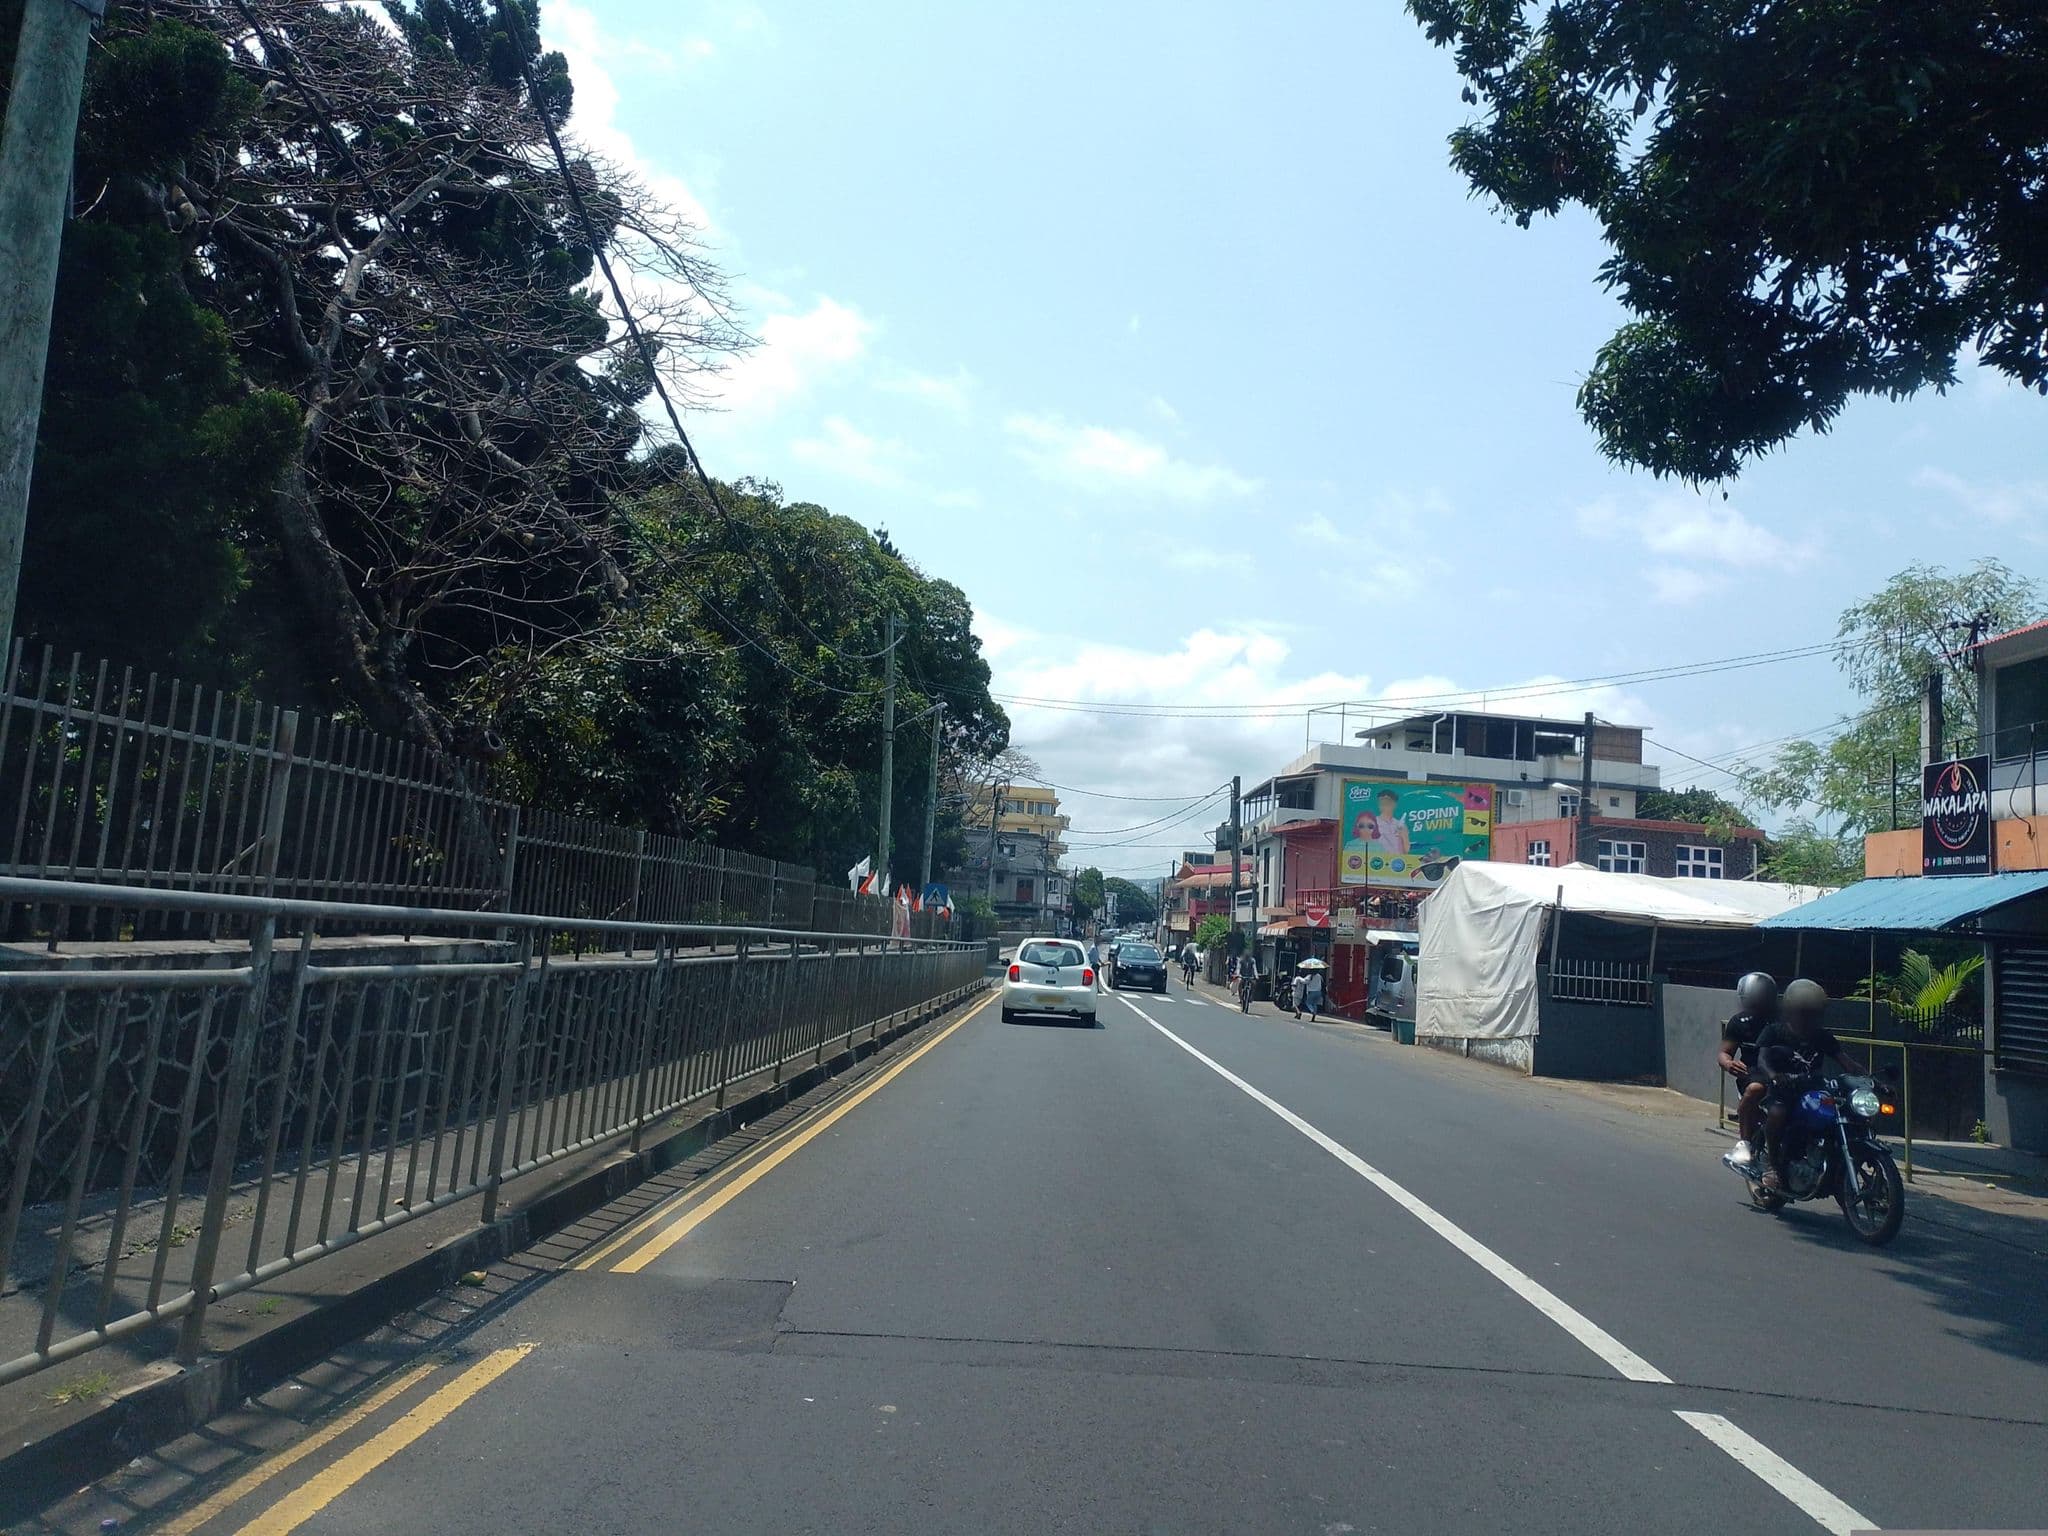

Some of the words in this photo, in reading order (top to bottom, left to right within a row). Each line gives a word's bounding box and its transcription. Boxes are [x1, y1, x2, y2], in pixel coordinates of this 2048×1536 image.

[1923, 790, 1988, 817] WAKALAPA
[1408, 806, 1459, 821] SOPINN
[1413, 821, 1423, 832] &
[1426, 818, 1453, 830] WIN
